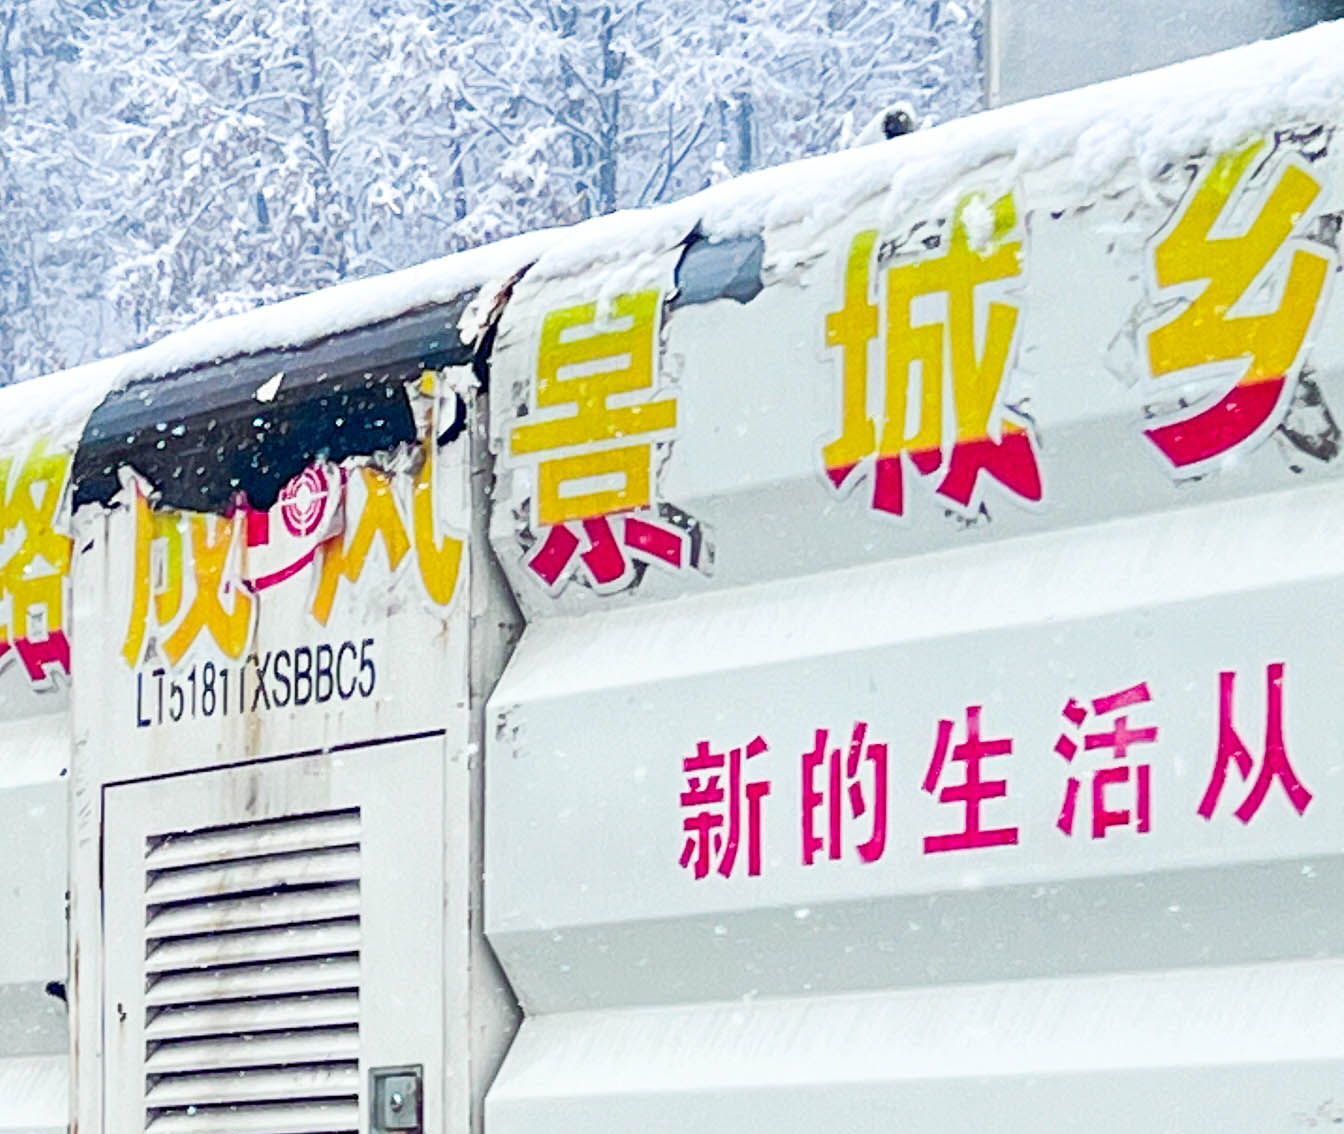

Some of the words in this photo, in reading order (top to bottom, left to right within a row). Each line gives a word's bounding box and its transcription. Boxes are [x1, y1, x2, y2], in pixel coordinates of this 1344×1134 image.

[678, 661, 1314, 881] 新的生活从
